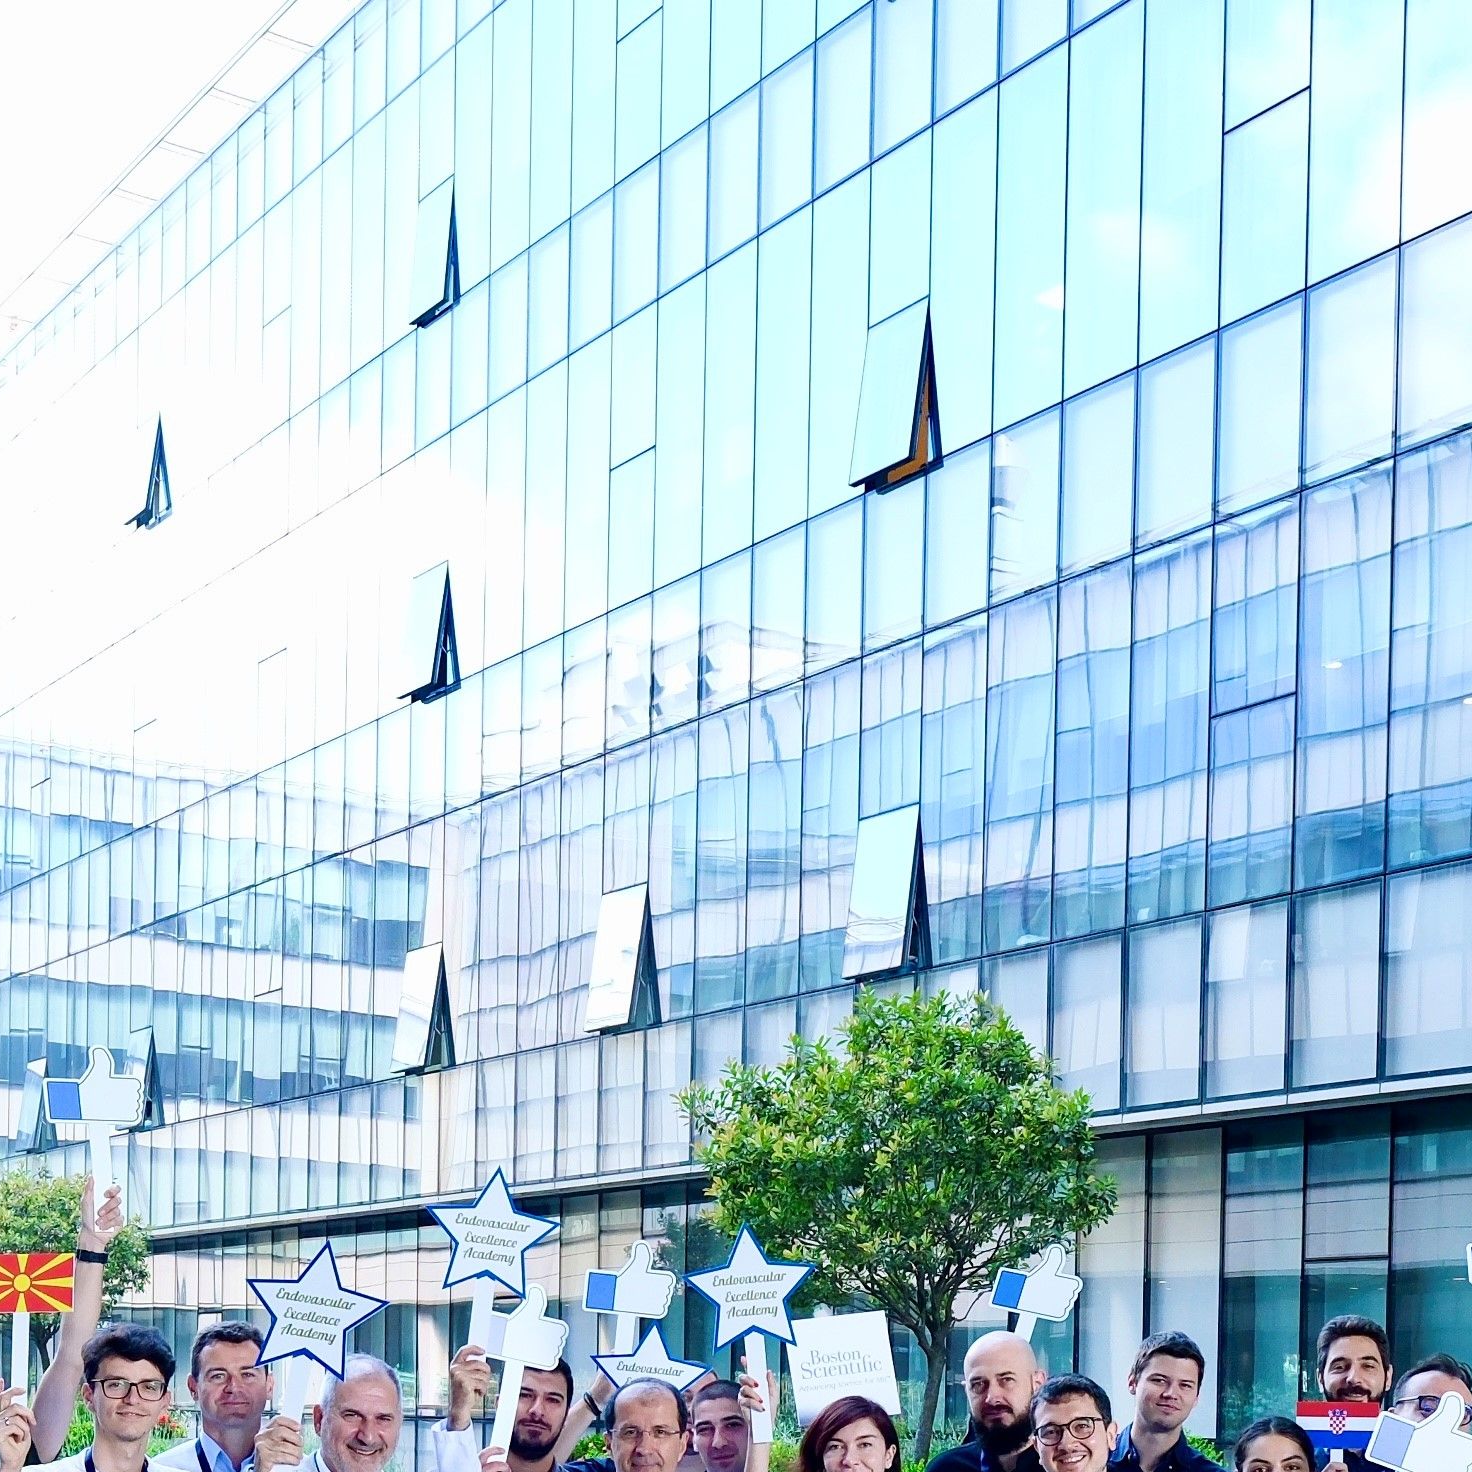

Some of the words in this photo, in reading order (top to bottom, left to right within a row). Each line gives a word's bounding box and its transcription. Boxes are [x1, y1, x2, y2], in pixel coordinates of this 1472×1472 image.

[455, 1212, 531, 1233] Endovascular
[464, 1230, 518, 1248] Excellence
[463, 1247, 515, 1267] Academy
[712, 1271, 787, 1287] Endovascular
[275, 1287, 357, 1310] Endovascular
[725, 1290, 778, 1303] Excellence
[284, 1307, 341, 1327] Excellence
[726, 1305, 778, 1319] Academy
[280, 1323, 337, 1346] Academy
[810, 1349, 861, 1365] Boston
[616, 1360, 685, 1377] Endovascular
[800, 1354, 883, 1380] Scientific
